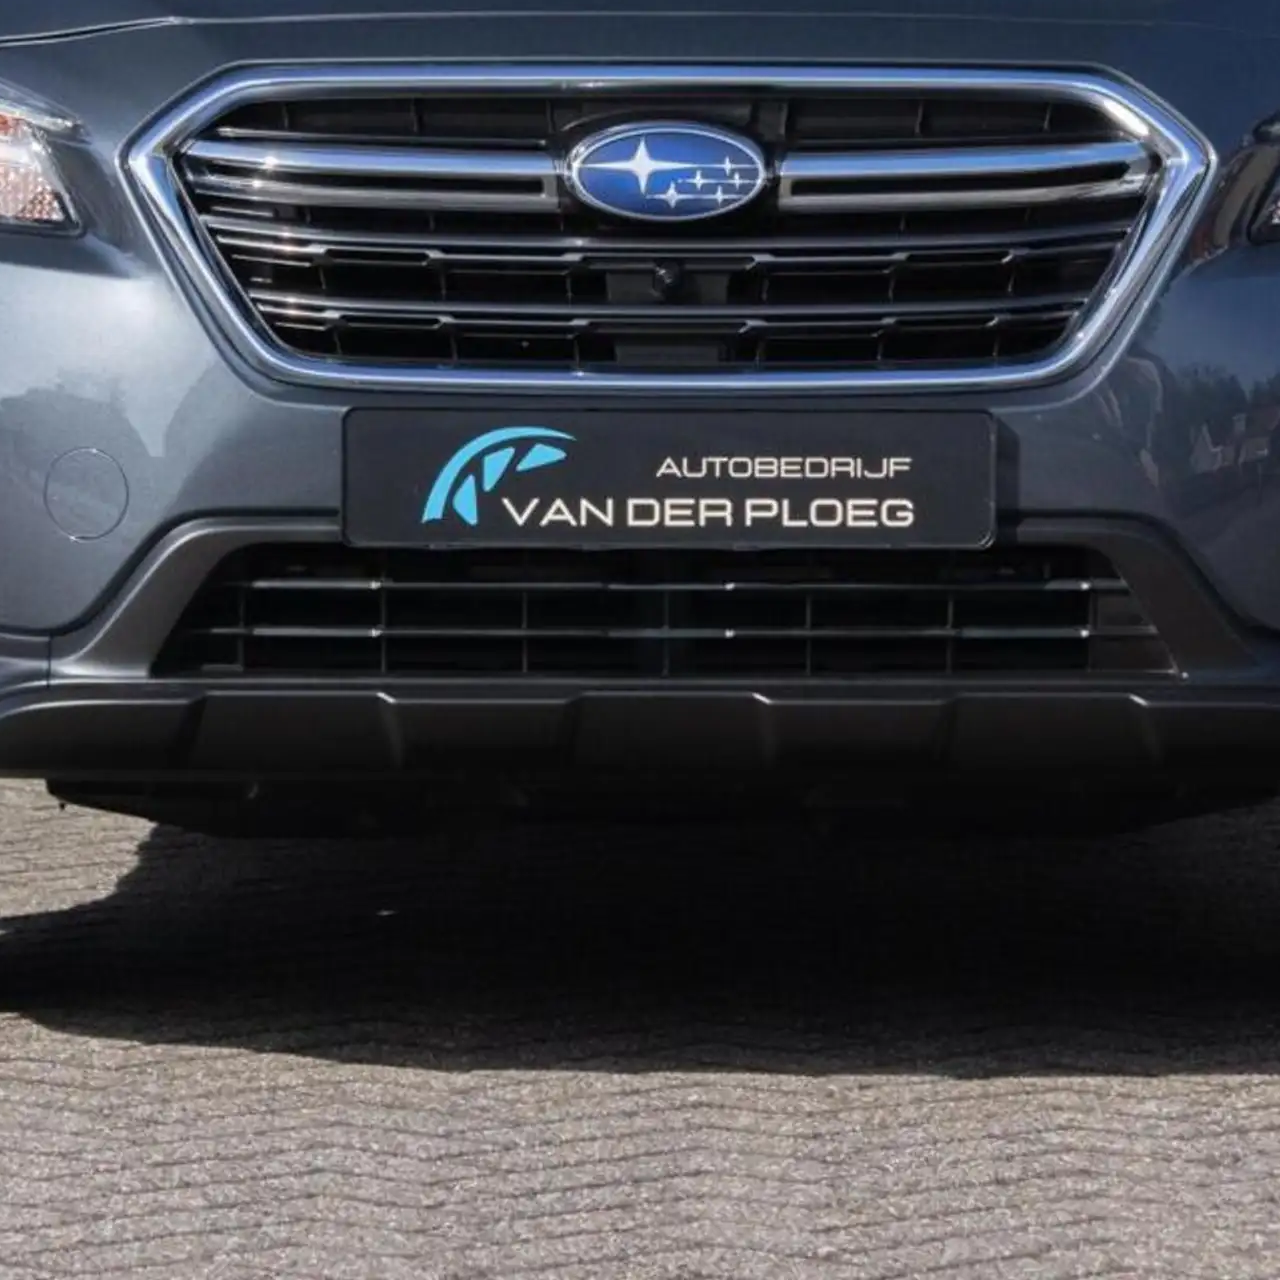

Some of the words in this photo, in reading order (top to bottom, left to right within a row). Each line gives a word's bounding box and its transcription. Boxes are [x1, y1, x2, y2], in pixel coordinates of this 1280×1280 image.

[655, 456, 913, 479] AUTOBEDRIJF
[501, 497, 614, 527] VAN
[626, 497, 734, 527] DER
[744, 497, 915, 528] PLOEG
